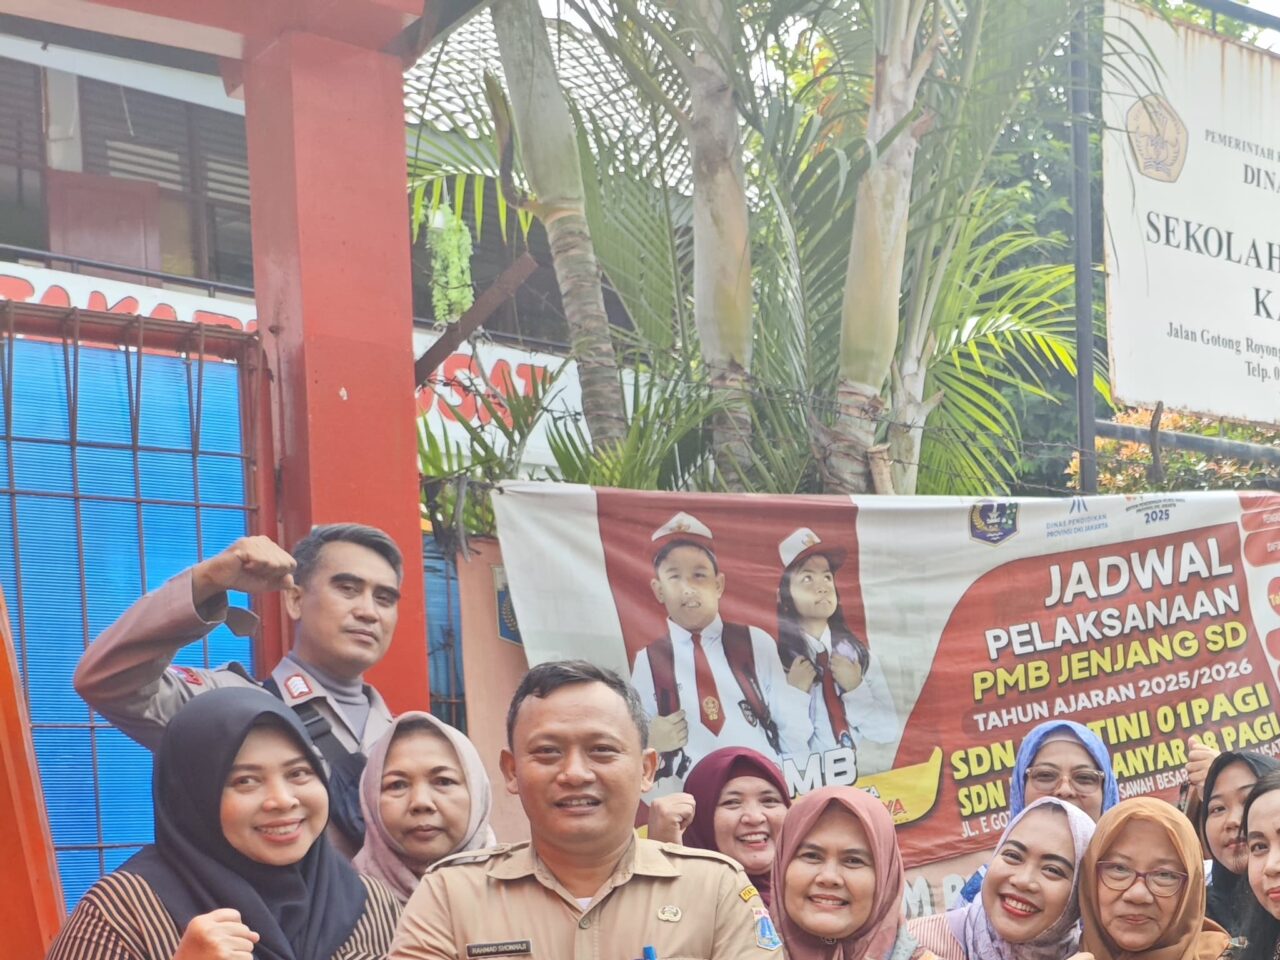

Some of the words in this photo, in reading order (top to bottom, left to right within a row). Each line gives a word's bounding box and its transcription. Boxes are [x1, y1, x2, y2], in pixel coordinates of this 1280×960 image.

[1205, 129, 1274, 160] PEMERINTAH
[1167, 321, 1197, 343] Jalan
[1200, 328, 1241, 355] Gotong
[1245, 361, 1271, 383] Telp.
[1144, 509, 1170, 524] 2025
[1044, 537, 1234, 608] JADWAL
[984, 584, 1241, 660] PELAKSANAAN
[972, 660, 1051, 702] PMB
[1056, 629, 1200, 685] JENJANG
[1204, 620, 1249, 654] SD
[973, 701, 1050, 733] TAHUN
[1053, 687, 1136, 718] AJARAN
[1138, 658, 1254, 702] 2025/2026
[782, 746, 859, 798] MB
[950, 740, 1016, 781] SDN
[958, 779, 1007, 817] SDN
[961, 820, 979, 839] JL.
[980, 816, 990, 835] E
[1118, 779, 1155, 800] SAWAH
